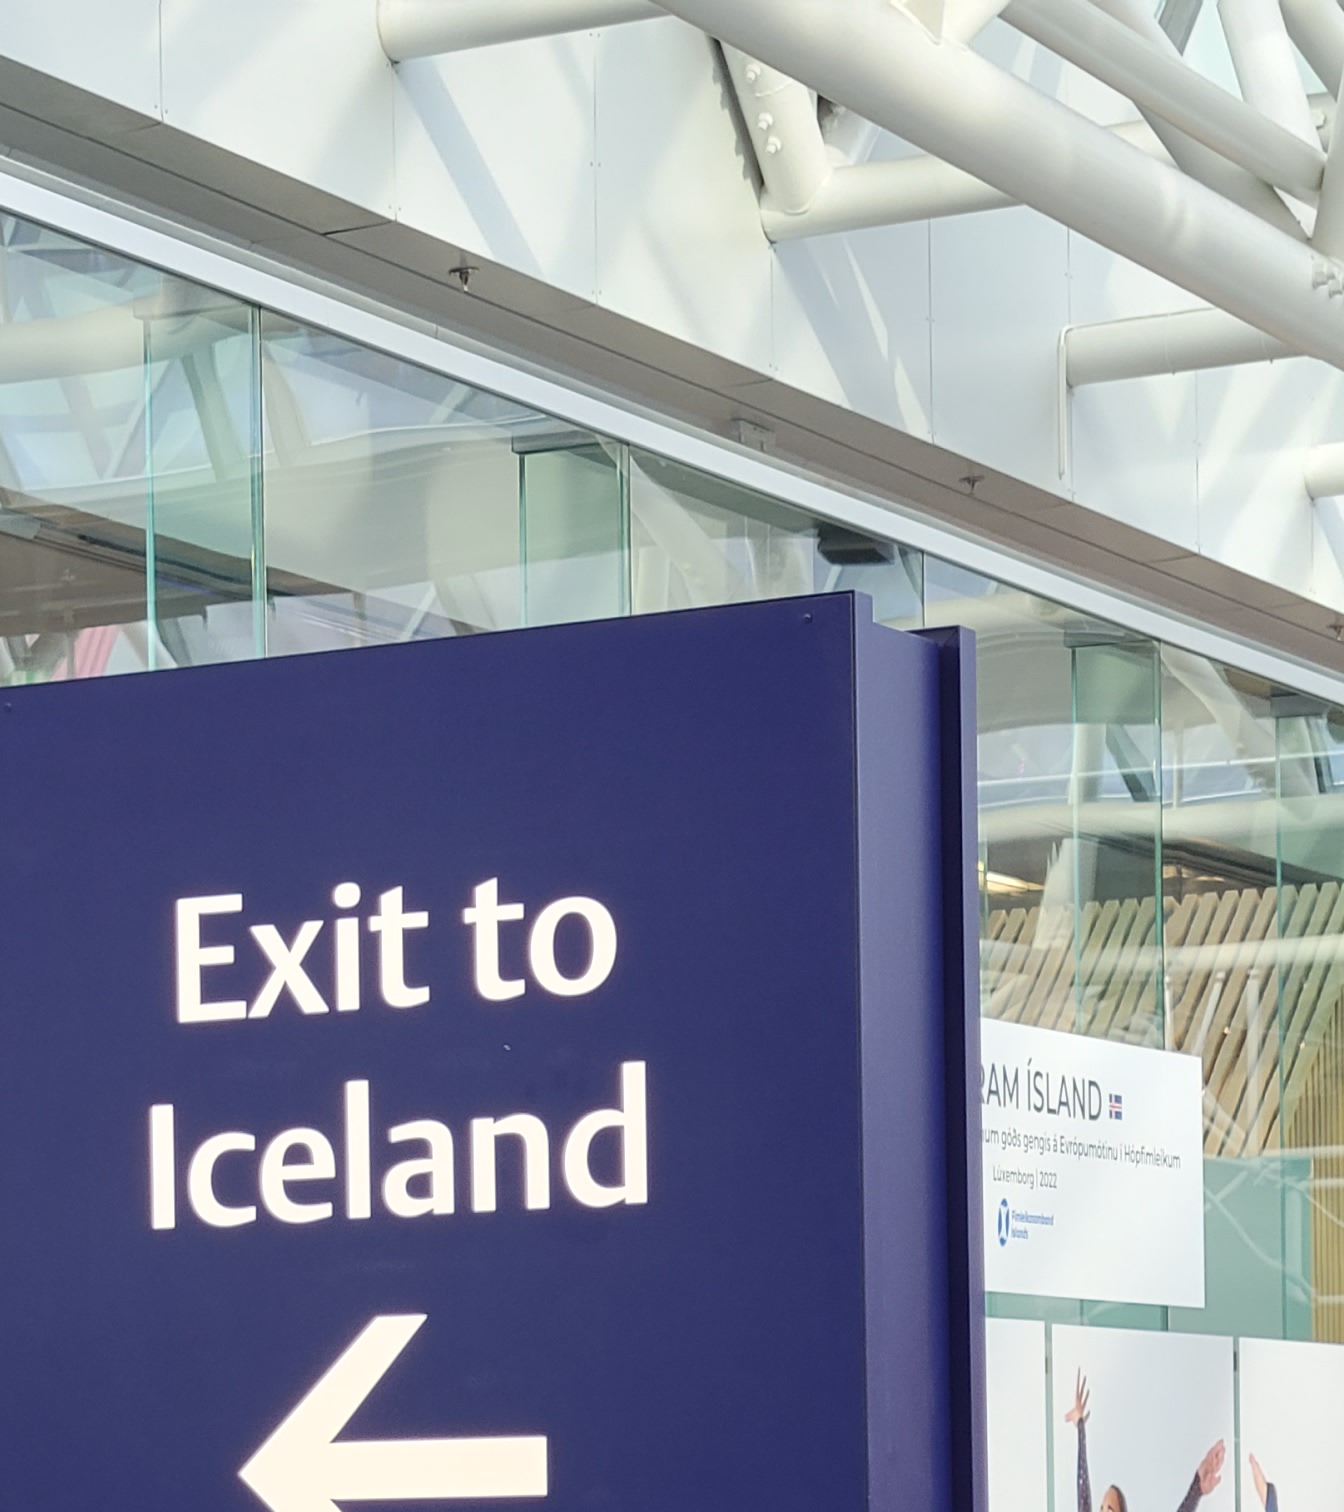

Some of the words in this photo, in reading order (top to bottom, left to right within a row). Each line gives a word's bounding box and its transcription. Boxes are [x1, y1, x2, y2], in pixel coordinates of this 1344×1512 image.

[176, 881, 430, 1024] Exit
[462, 876, 618, 1001] to
[1027, 1057, 1102, 1121] ÍSLAND
[149, 1060, 648, 1230] Iceland
[1023, 1131, 1051, 1155] gengis
[1039, 1170, 1057, 1189] 2022
